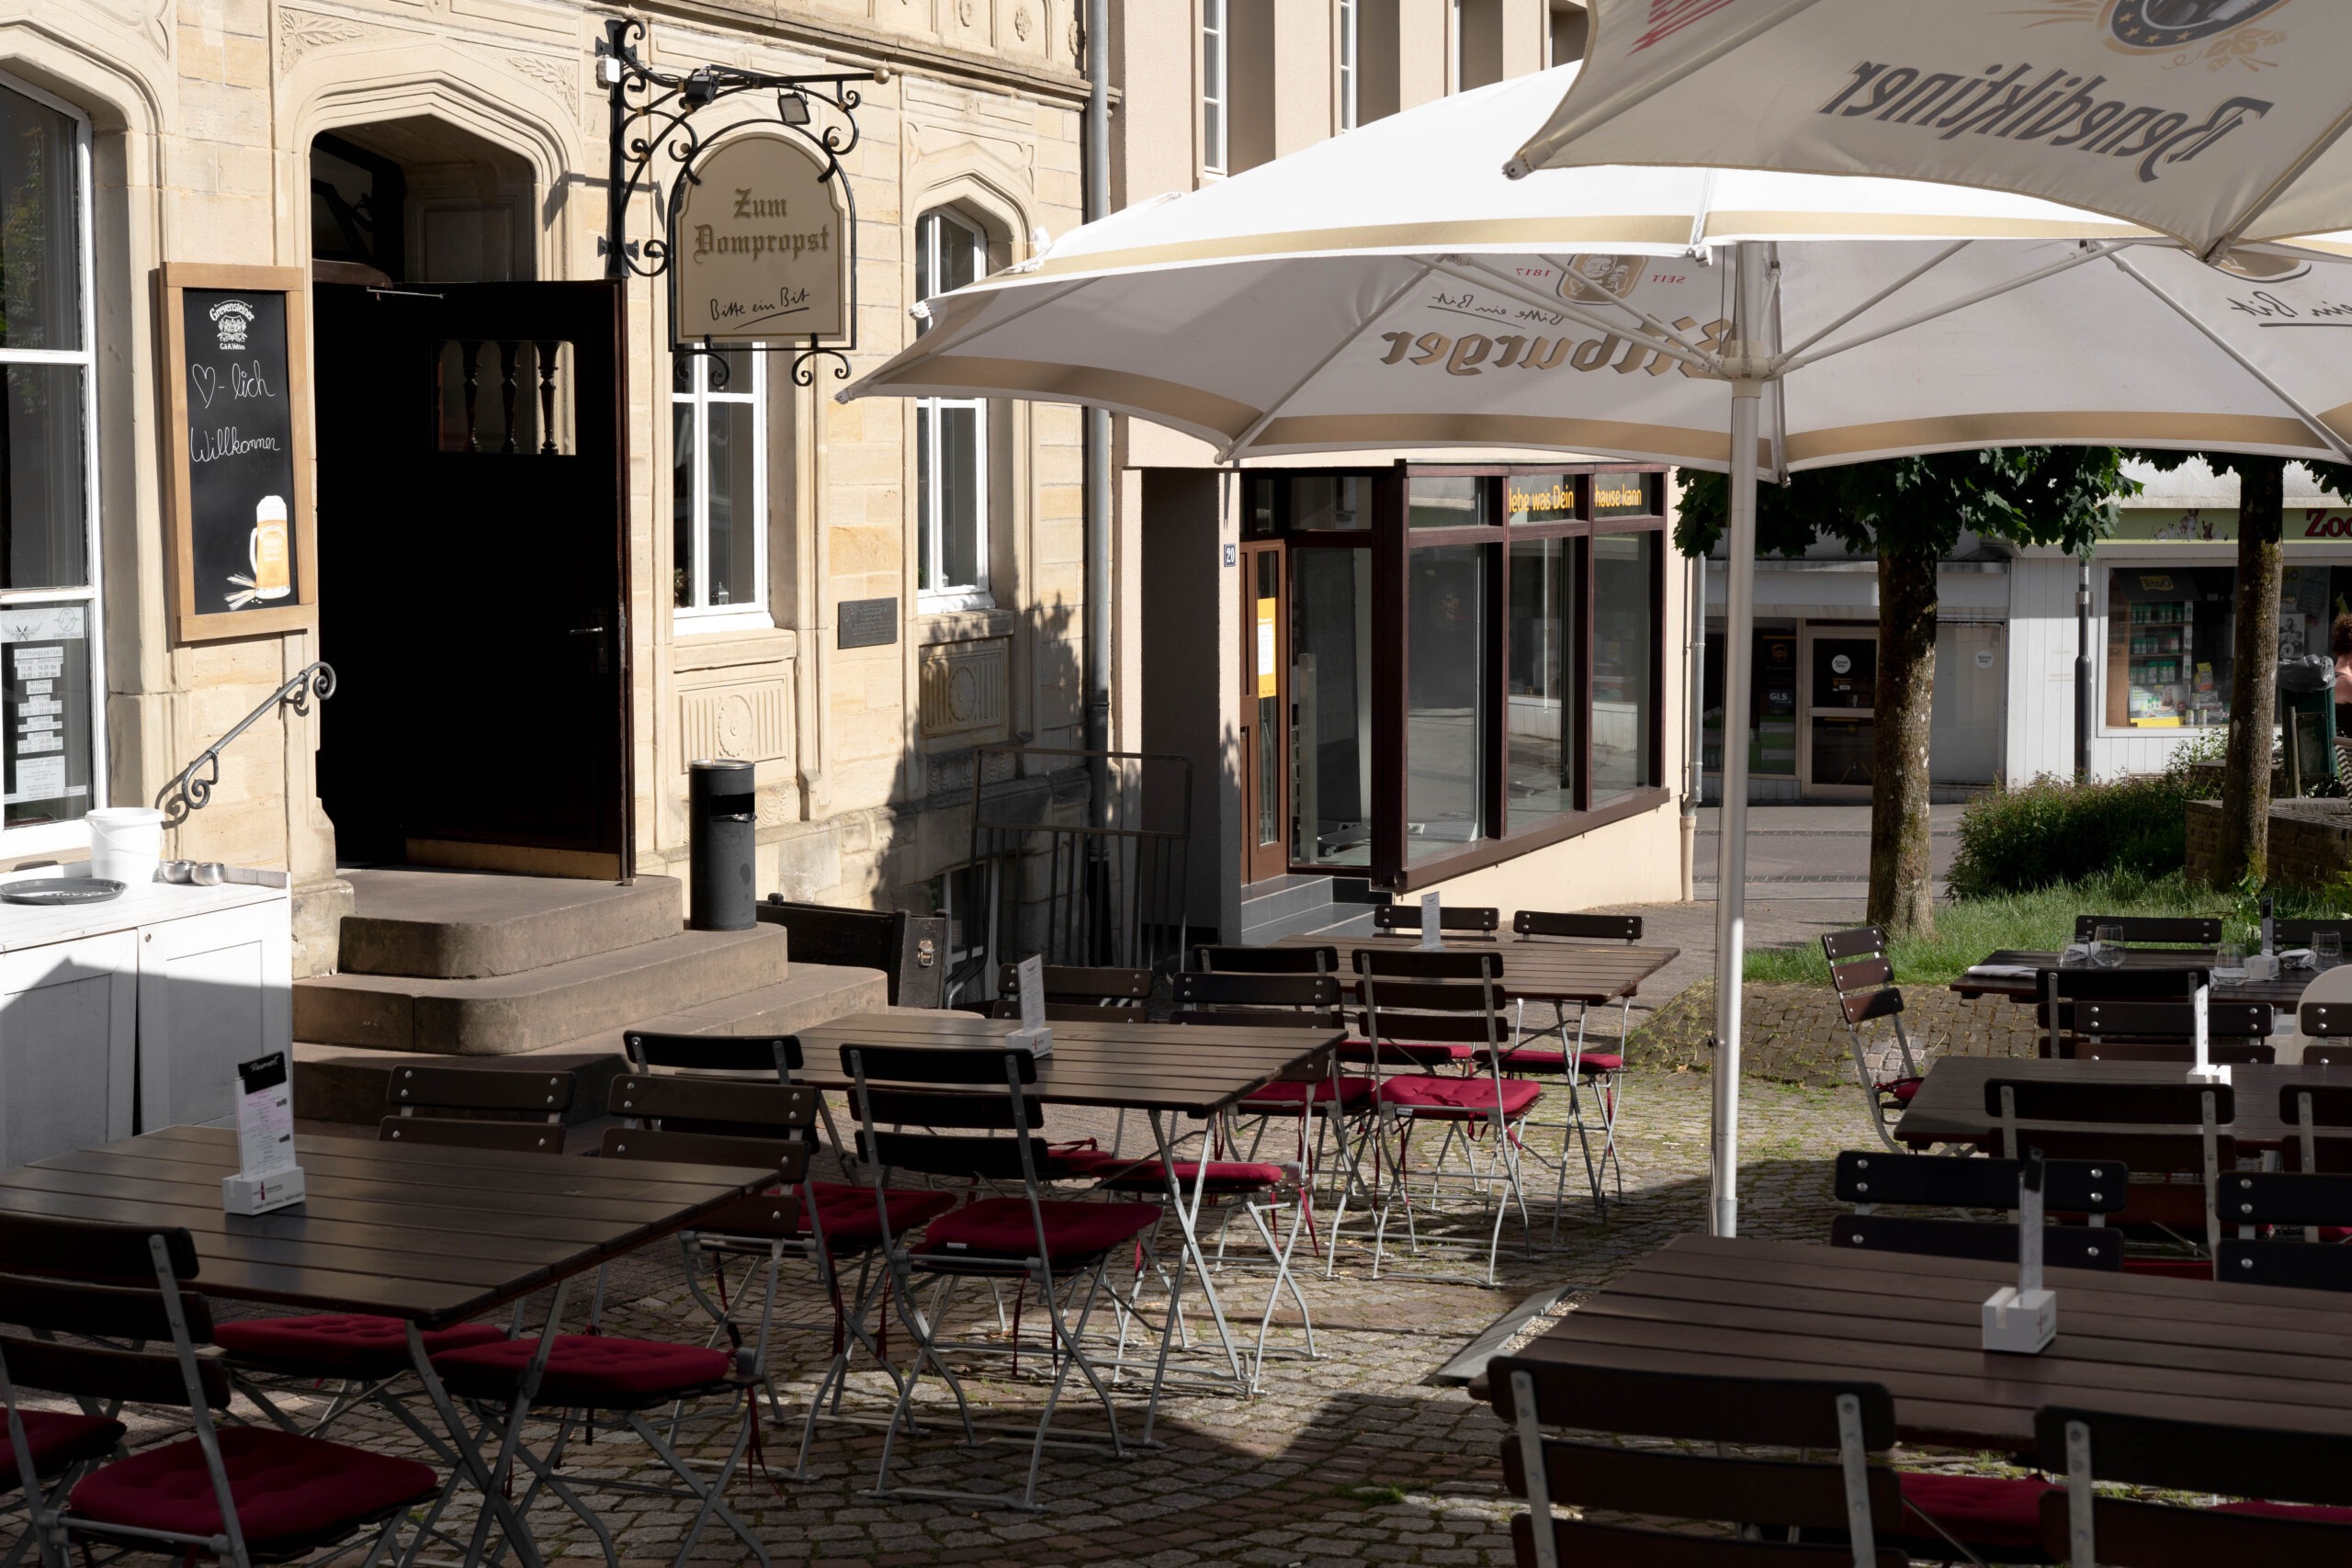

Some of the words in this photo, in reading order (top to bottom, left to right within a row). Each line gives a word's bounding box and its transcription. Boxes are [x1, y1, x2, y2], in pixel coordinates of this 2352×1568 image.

[732, 186, 788, 220] Zum
[693, 222, 830, 265] Dompropst
[209, 302, 254, 321] Grevensteiner
[709, 298, 746, 321] Bitte
[752, 299, 775, 313] ein
[780, 286, 810, 308] Bit
[1532, 492, 1551, 511] was
[1553, 484, 1574, 510] Dein
[1622, 483, 1643, 506] kann
[1226, 547, 1235, 563] 20
[1769, 693, 1788, 701] GLS
